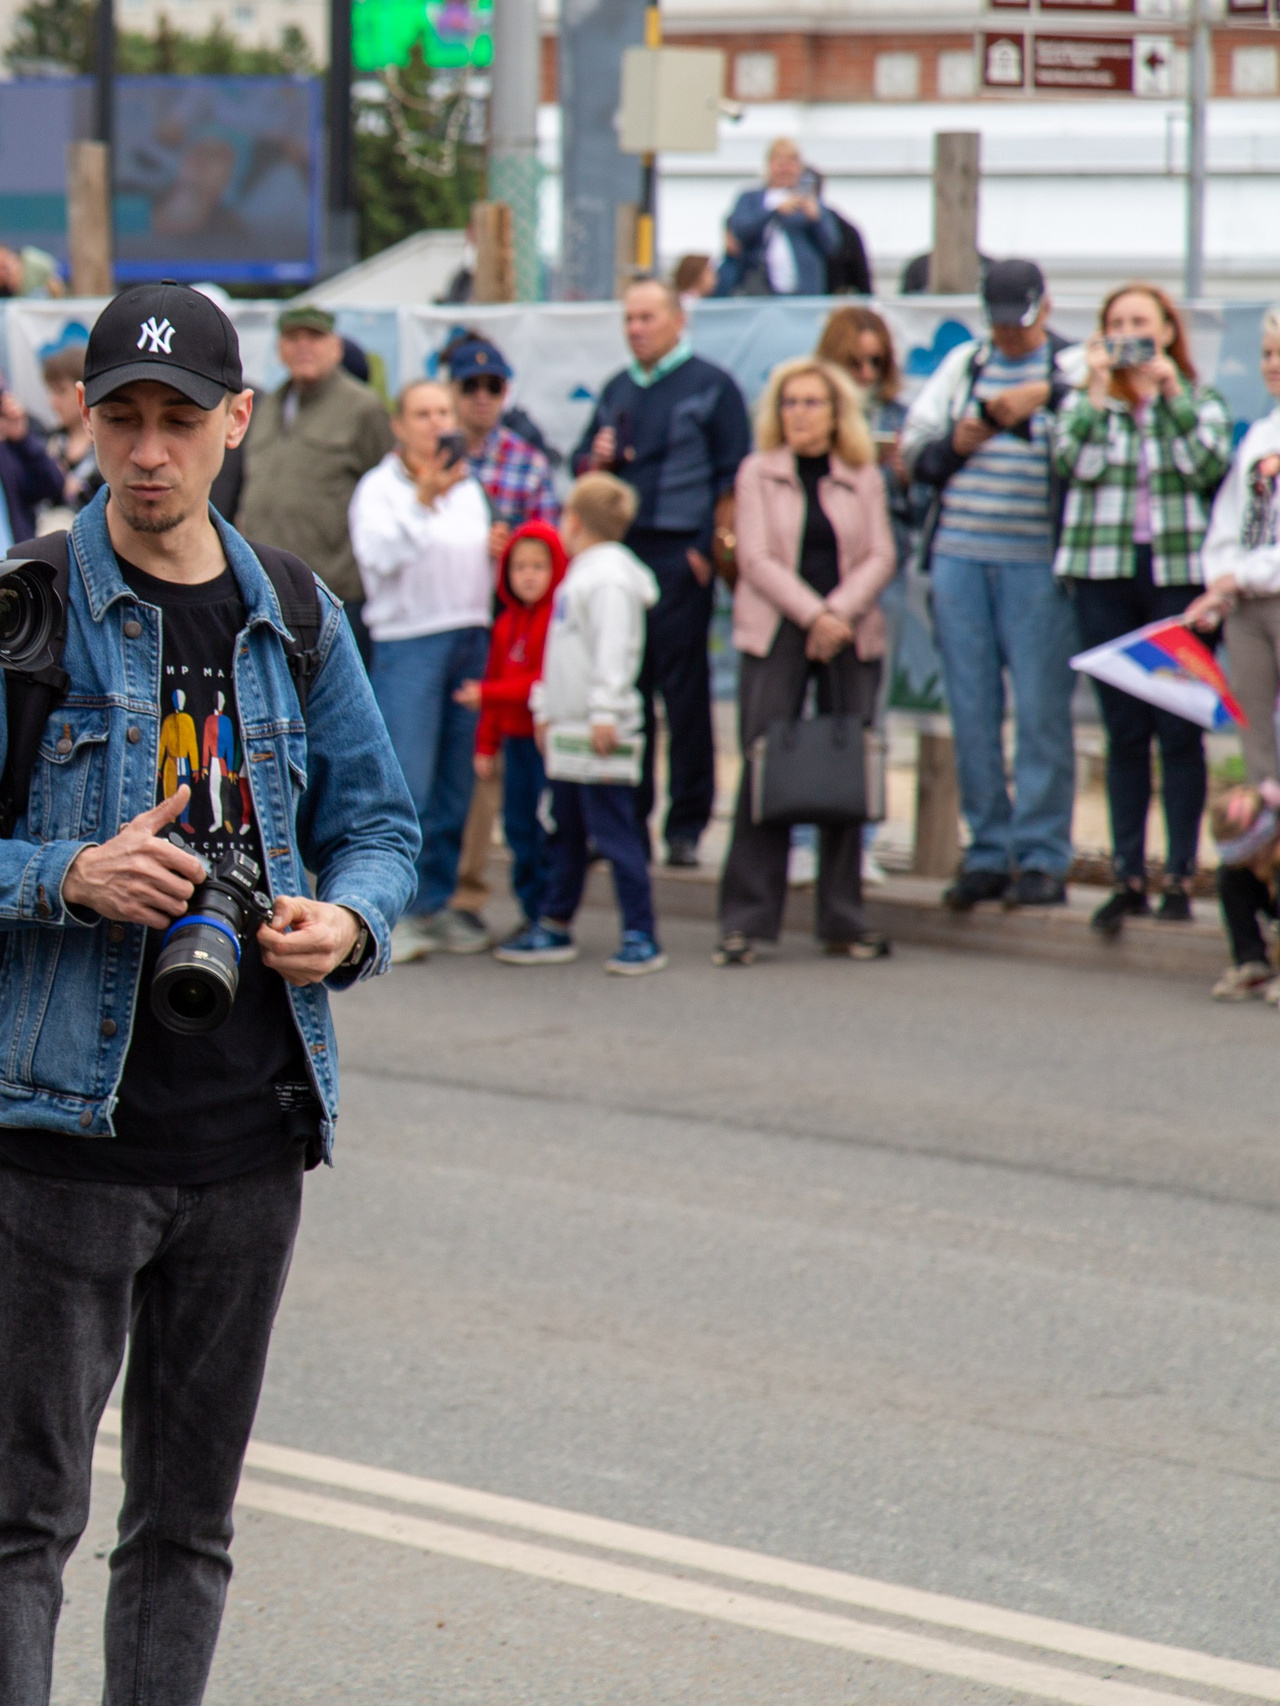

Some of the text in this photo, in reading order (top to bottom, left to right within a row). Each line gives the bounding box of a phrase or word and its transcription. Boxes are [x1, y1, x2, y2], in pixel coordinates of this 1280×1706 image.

[136, 316, 176, 355] NY
[166, 665, 233, 678] ИР МА
